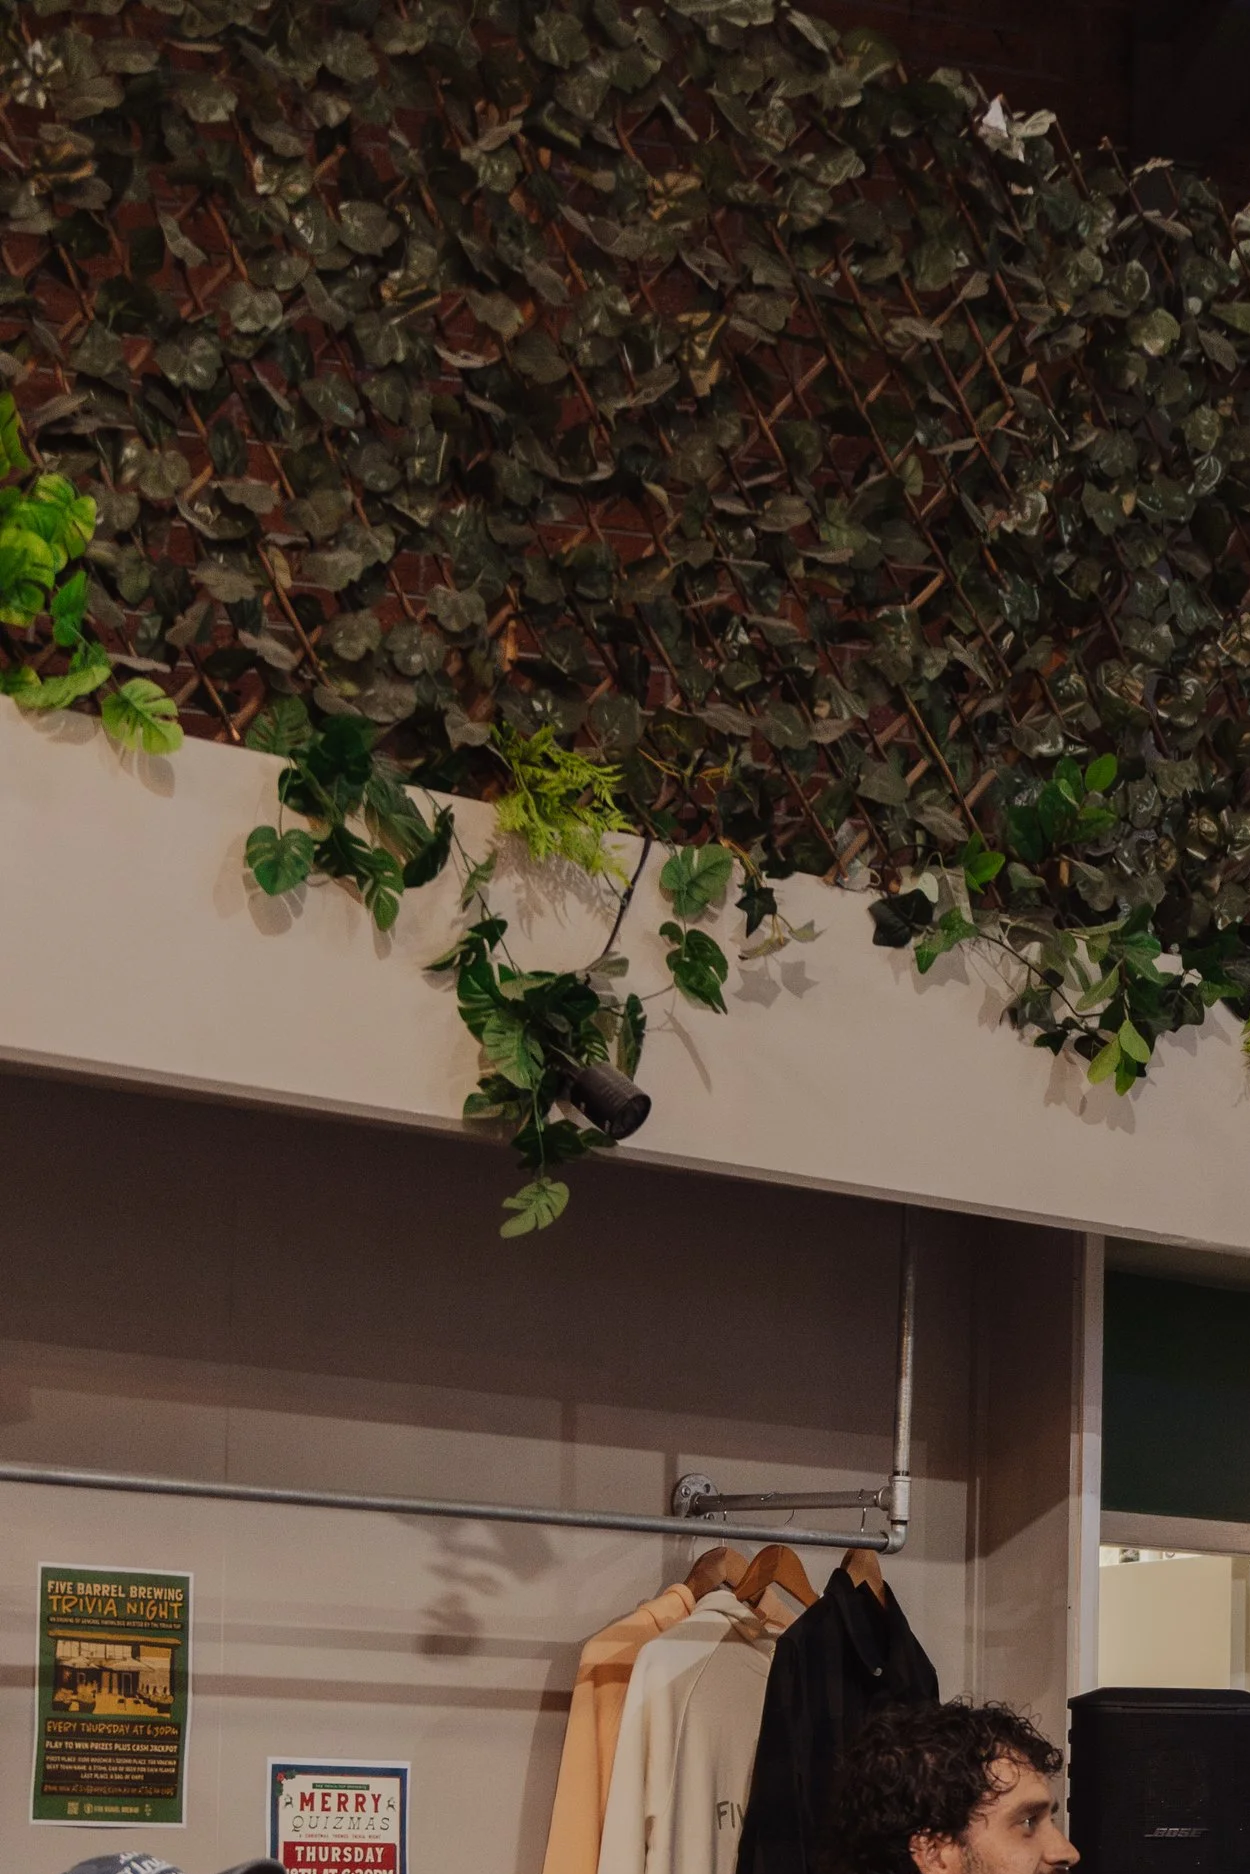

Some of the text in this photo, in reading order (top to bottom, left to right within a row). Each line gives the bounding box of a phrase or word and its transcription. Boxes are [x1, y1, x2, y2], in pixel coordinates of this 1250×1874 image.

[47, 1580, 184, 1601] FIVE BARREL BREWING
[48, 1595, 183, 1621] TRIVIA NIGHT
[46, 1720, 77, 1733] EVERY
[80, 1722, 129, 1735] THURSDAY
[132, 1725, 144, 1735] AT
[46, 1741, 178, 1754] PLAY TO WIN PRIZES PLUS CASH JACKPOT
[299, 1790, 383, 1814] MERRY
[291, 1814, 391, 1833] QUIZMAS
[1144, 1827, 1208, 1838] BOSE
[295, 1845, 385, 1863] THURSDAY
